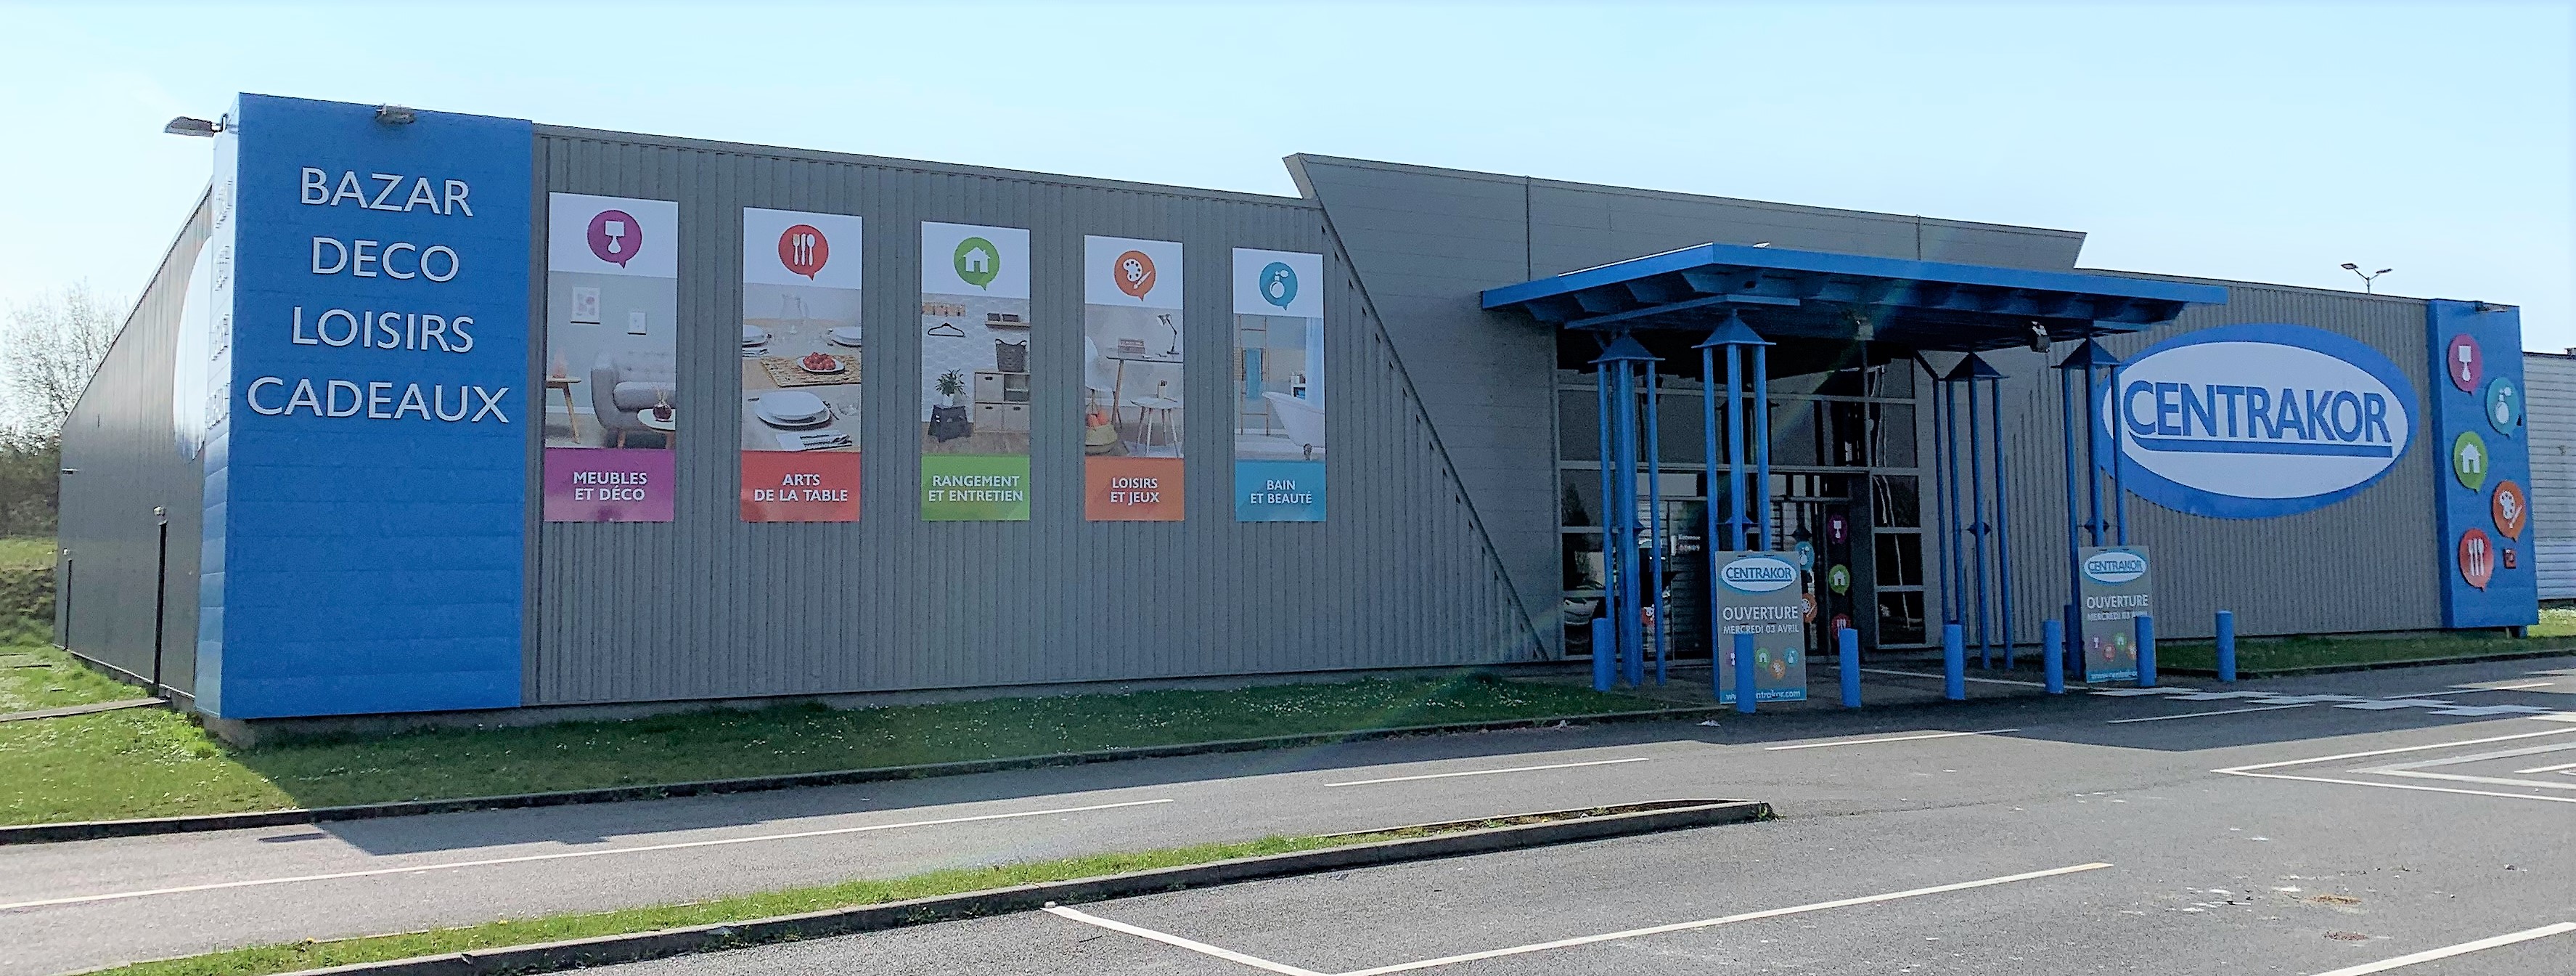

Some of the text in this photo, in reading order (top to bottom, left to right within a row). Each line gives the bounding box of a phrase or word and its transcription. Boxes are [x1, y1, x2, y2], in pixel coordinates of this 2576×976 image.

[300, 167, 473, 216] BAZAR
[312, 237, 459, 282] DECO
[293, 306, 474, 353] LOISIRS
[248, 377, 510, 423] CADEAUX
[2123, 380, 2392, 443] CENTRAKOR
[573, 471, 647, 484] MEUBLES
[782, 474, 820, 487] ARTS
[932, 475, 1019, 487] RANGEMENT
[1112, 477, 1158, 489] LOISIRS
[1267, 480, 1295, 490] BAIN
[575, 485, 645, 501] ET DÉCO
[754, 489, 848, 501] DE LA TABLE
[928, 489, 1023, 502] ET ENTRETIEN
[1111, 492, 1159, 504] ET JEUX
[1250, 491, 1312, 504] ET BEAUTÉ
[1725, 567, 1792, 580] CENTRAKOR
[2086, 595, 2148, 609] OUVERTURE
[1722, 606, 1798, 621] OUVERTURE
[1723, 624, 1799, 635] MERCREDI 03 AVRIL
